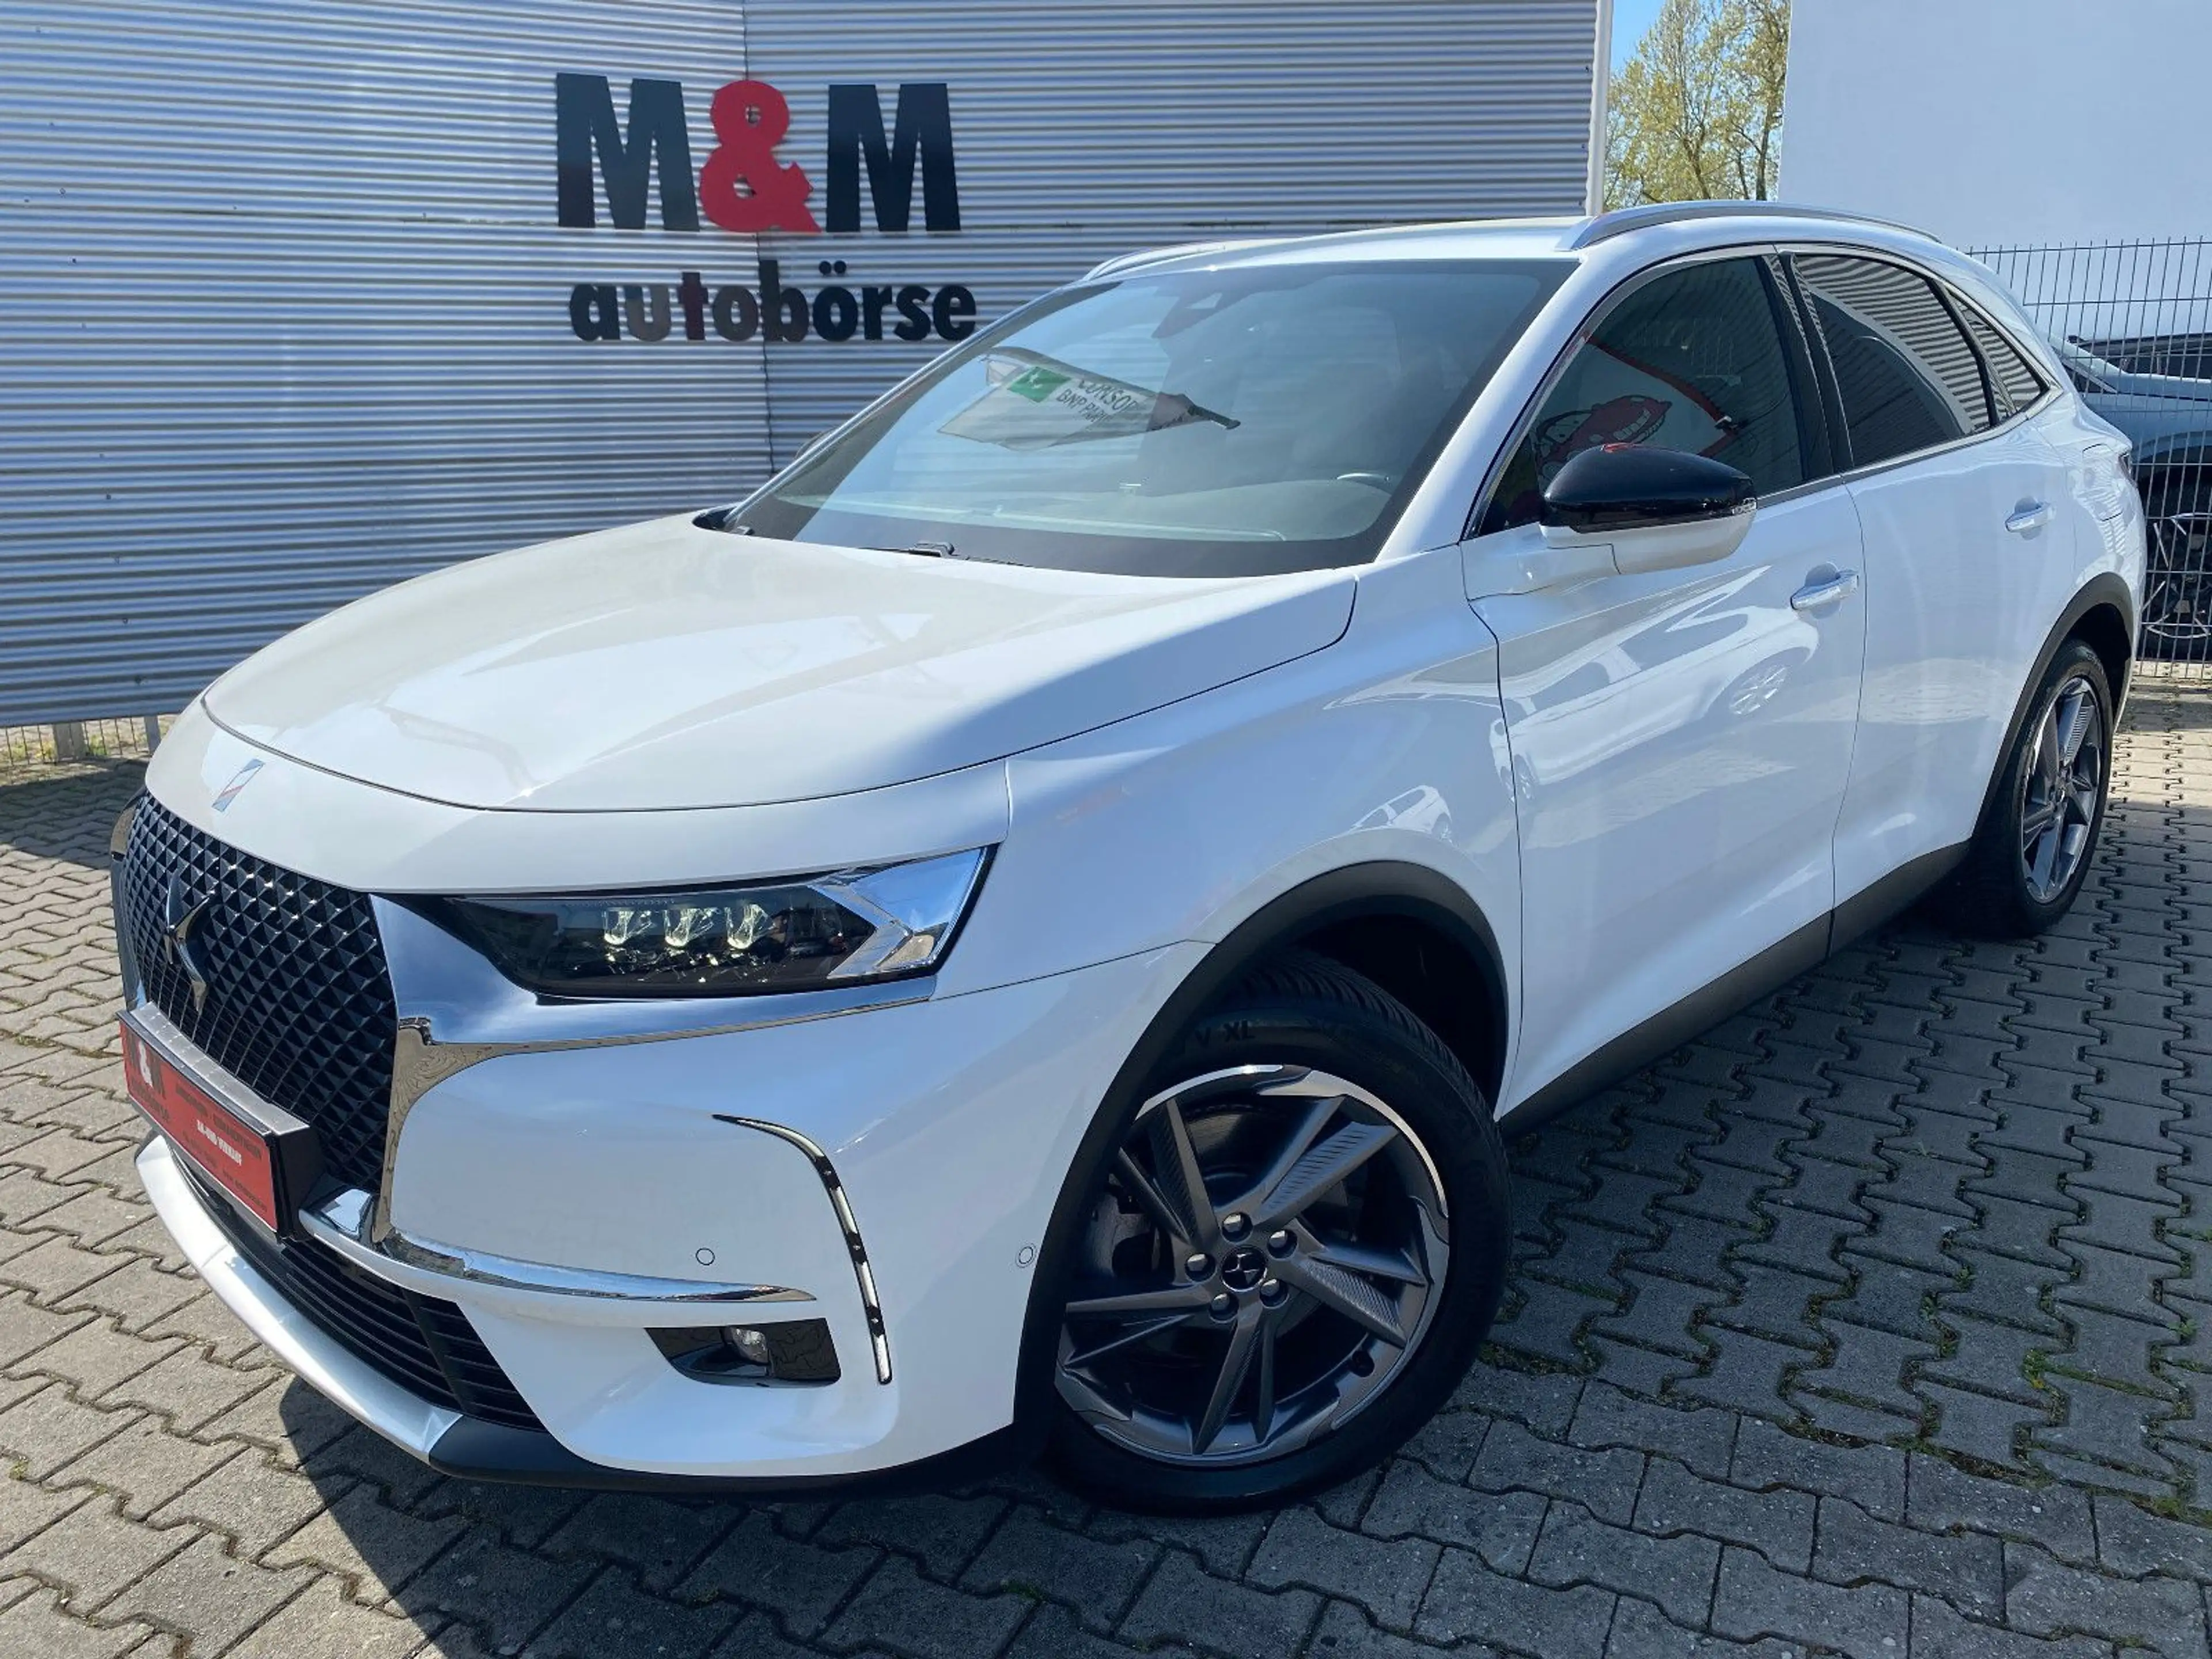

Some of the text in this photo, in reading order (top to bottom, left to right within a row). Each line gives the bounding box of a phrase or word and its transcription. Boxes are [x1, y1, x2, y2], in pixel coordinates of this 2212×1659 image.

[556, 73, 961, 234] M&M
[570, 259, 977, 342] autobörse
[1056, 388, 1087, 410] BNP
[1222, 1019, 1256, 1043] XL
